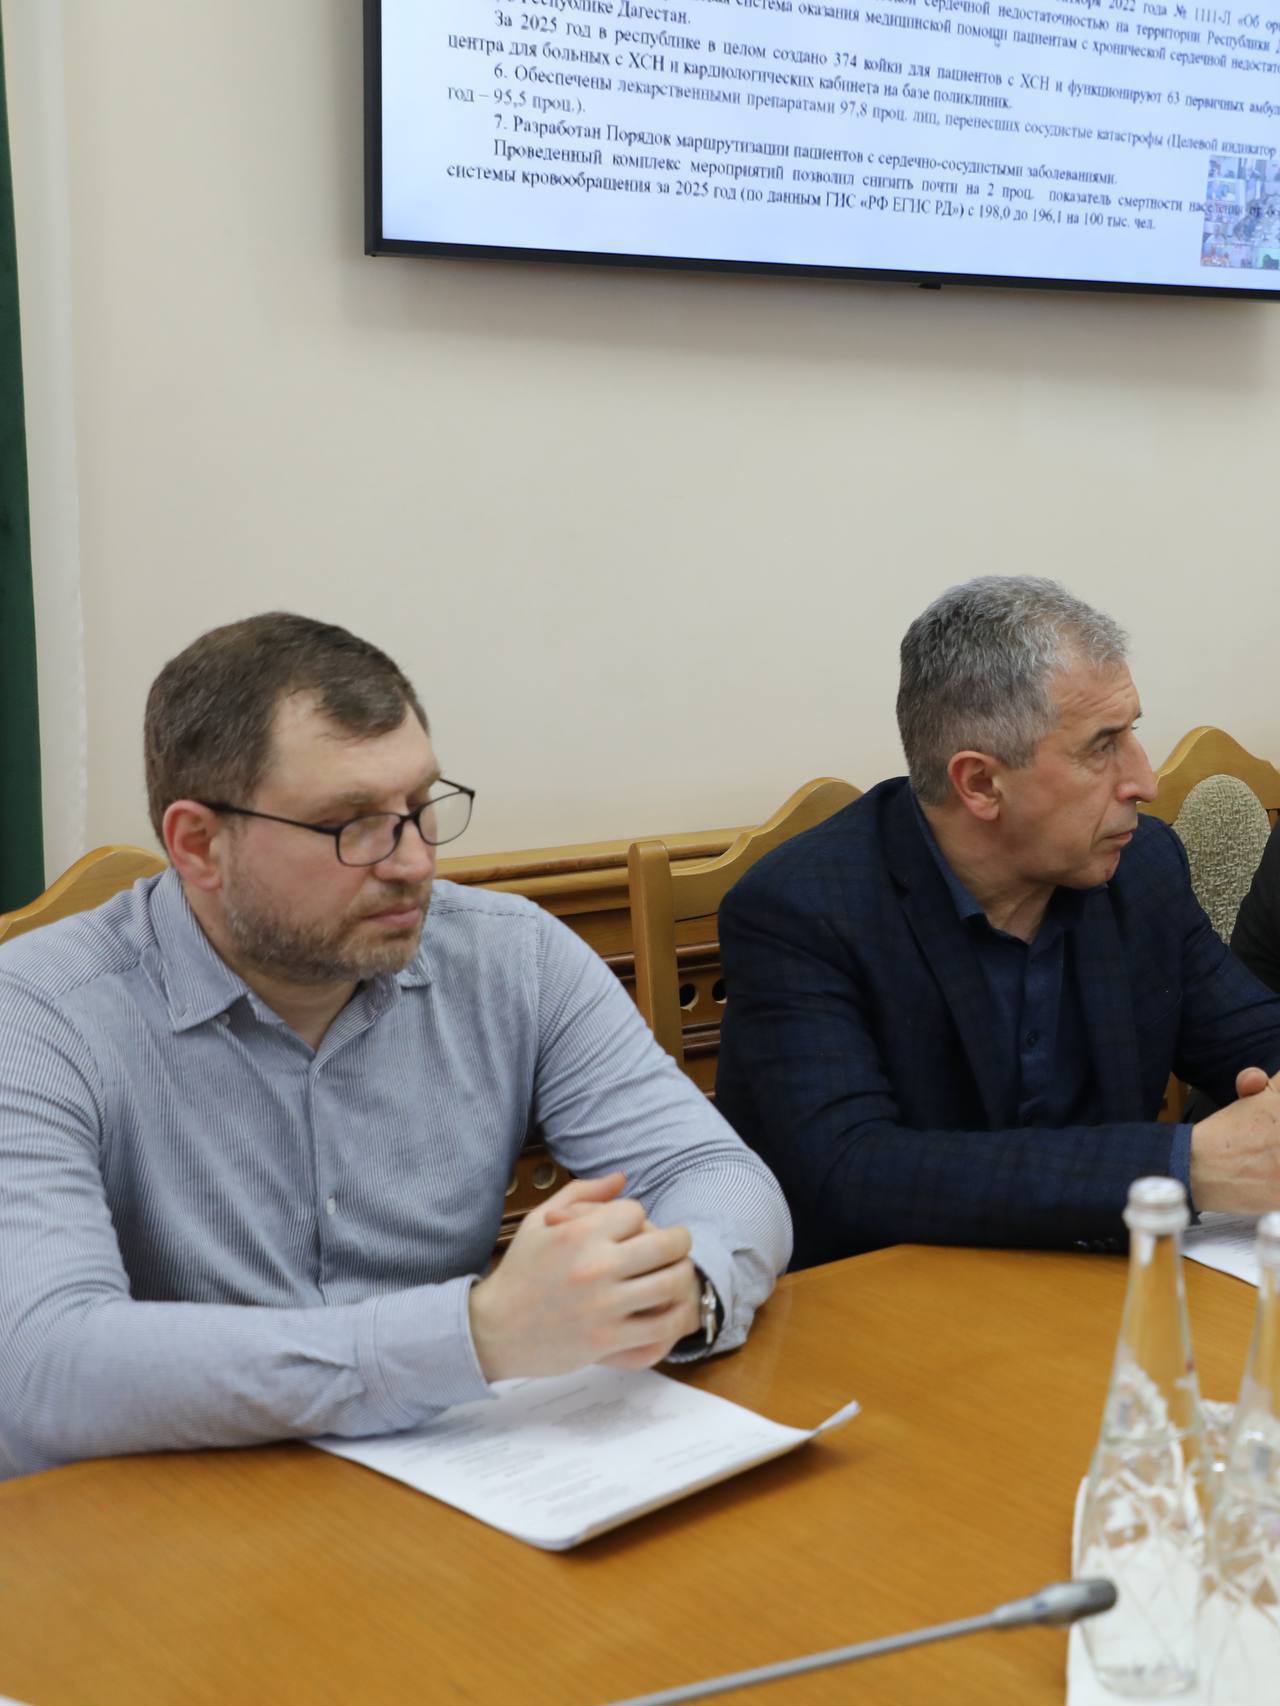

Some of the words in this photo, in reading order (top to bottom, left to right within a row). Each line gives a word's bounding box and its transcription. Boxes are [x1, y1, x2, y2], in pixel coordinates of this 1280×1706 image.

[617, 0, 691, 24] Дагестан.
[798, 3, 859, 22] оказания
[864, 12, 951, 34] медицинской
[957, 23, 1008, 41] помощи
[1013, 30, 1077, 49] пациентам
[1092, 40, 1166, 60] хронической
[1170, 50, 1227, 67] сердечной
[998, 5, 1109, 31] недостаточностью
[1116, 21, 1129, 33] на
[1136, 23, 1201, 43] территории
[1207, 30, 1270, 52] Республики
[1143, 3, 1167, 16] года
[448, 34, 504, 56] центра
[508, 41, 537, 57] для
[542, 41, 610, 66] больных
[615, 54, 623, 66] с
[628, 51, 664, 72] ХСН
[670, 60, 679, 74] и
[683, 61, 814, 88] кардиологических
[819, 75, 879, 95] кабинета
[884, 84, 898, 97] на
[902, 83, 930, 100] базе
[934, 89, 1012, 109] поликлиник.
[494, 9, 512, 27] За
[521, 13, 557, 33] 2025
[566, 22, 591, 38] год
[599, 26, 607, 39] в
[615, 29, 701, 50] республике
[708, 40, 716, 52] в
[723, 41, 766, 58] целом
[773, 48, 827, 65] создано
[833, 52, 857, 68] 374
[864, 58, 902, 75] койки
[908, 63, 930, 78] для
[937, 67, 1002, 85] пациентов
[1007, 75, 1014, 87] с
[1020, 73, 1049, 91] ХСН
[1055, 80, 1063, 93] и
[1068, 80, 1162, 104] функционируют
[1167, 91, 1180, 105] 63
[1185, 94, 1244, 112] первичных
[448, 87, 474, 103] год
[493, 88, 527, 108] 95,5
[532, 94, 586, 115] проц.).
[494, 62, 508, 79] 6.
[515, 64, 612, 91] Обеспечены
[617, 79, 741, 105] лекарственными
[747, 92, 835, 114] препаратами
[840, 100, 868, 118] 97,8
[872, 106, 907, 122] проц.
[945, 113, 1020, 132] перенесших
[1024, 121, 1093, 139] сосудистые
[1096, 131, 1164, 149] катастрофы
[1167, 133, 1218, 151] (Целевой
[1221, 141, 1277, 159] индикатор
[494, 113, 508, 130] 7.
[513, 115, 601, 140] Разработан
[606, 124, 671, 147] Порядок
[676, 135, 789, 157] маршрутизации
[794, 145, 863, 162] пациентов
[867, 152, 874, 163] с
[878, 153, 1023, 177] сердечно-сосудистыми
[1027, 164, 1118, 185] заболеваниями.
[494, 139, 602, 165] Проведенный
[612, 153, 681, 171] комплекс
[690, 160, 784, 180] мероприятий
[792, 168, 854, 186] позволил
[862, 175, 914, 191] снизить
[921, 179, 958, 194] почти
[966, 184, 979, 196] на
[987, 182, 994, 197] 2
[1002, 185, 1034, 201] проц.
[1048, 190, 1111, 206] показатель
[1118, 195, 1182, 212] смертности
[447, 164, 516, 183] системы
[522, 171, 651, 193] кровообращения
[656, 181, 670, 195] за
[676, 180, 709, 197] 2025
[713, 186, 737, 201] год
[740, 186, 763, 203] (по
[767, 190, 821, 206] данным
[825, 191, 856, 208] ГИС
[860, 195, 889, 211] «РФ
[935, 200, 964, 218] РД»)
[968, 205, 974, 217] с
[979, 203, 1010, 221] 198,0
[1013, 209, 1028, 221] до
[1033, 209, 1062, 225] 196,1
[1067, 212, 1079, 224] на
[1084, 212, 1104, 226] 100
[1107, 215, 1130, 229] тыс.
[1134, 217, 1156, 230] чел.
